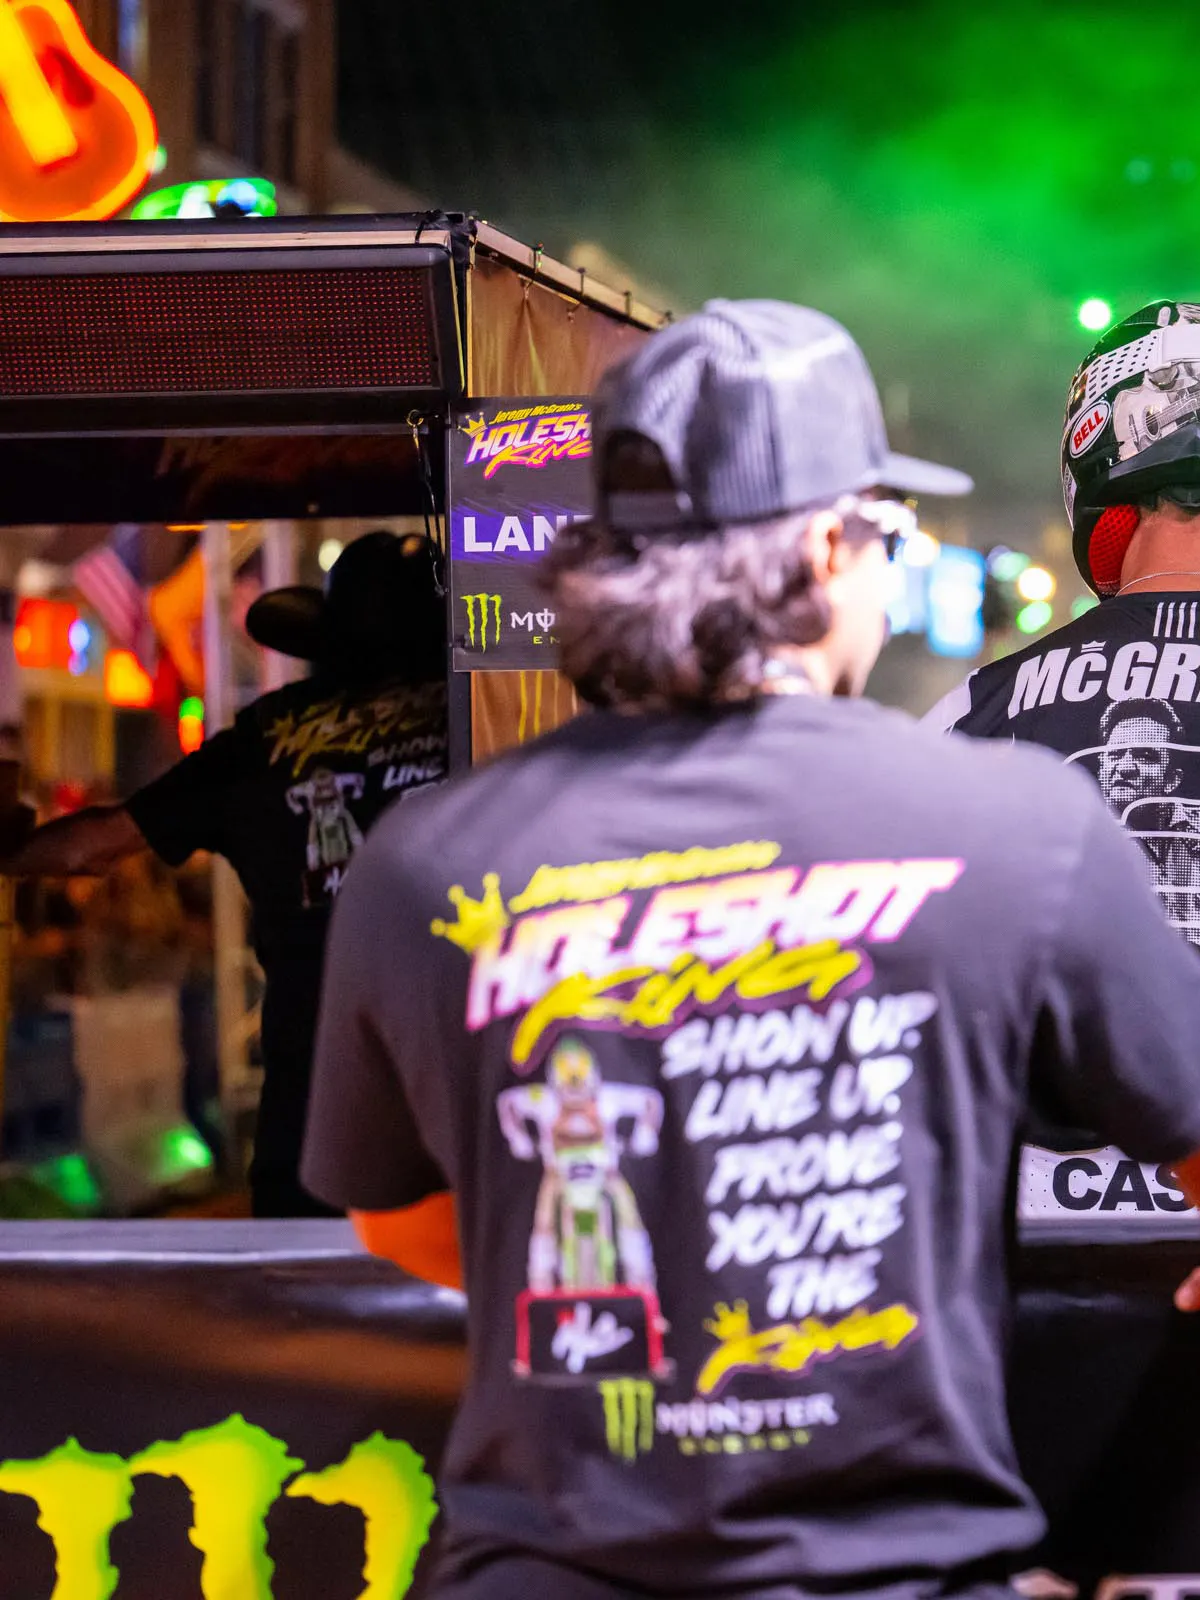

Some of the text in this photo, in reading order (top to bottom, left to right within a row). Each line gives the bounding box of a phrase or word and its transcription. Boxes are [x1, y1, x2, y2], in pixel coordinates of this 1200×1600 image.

[466, 414, 592, 464] HOLESH
[488, 408, 533, 425] Jeremy
[1073, 409, 1104, 450] BELL
[463, 514, 593, 553] LAN
[467, 857, 964, 1029] HOLESHOT
[661, 999, 849, 1078] SHOW
[685, 1068, 825, 1142] LINE
[706, 1122, 903, 1205] PROVE
[1052, 1158, 1197, 1212] CAS
[767, 1249, 883, 1320] THE
